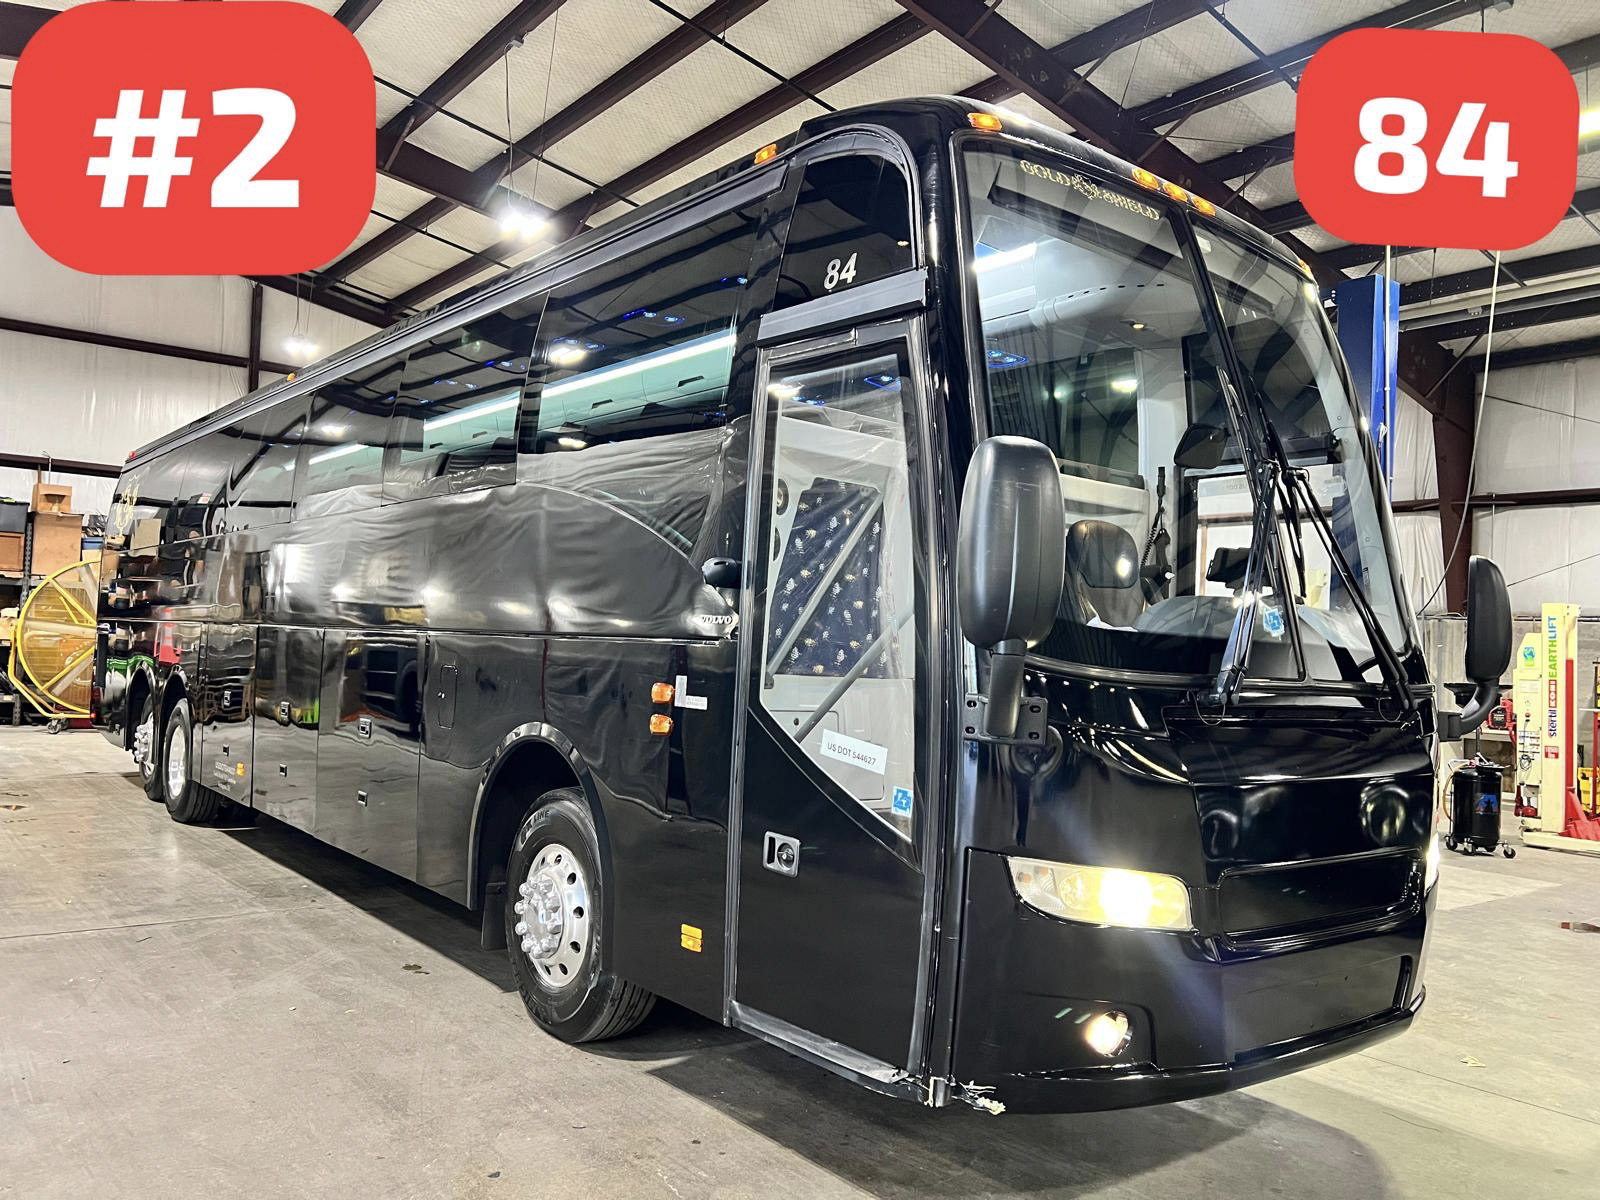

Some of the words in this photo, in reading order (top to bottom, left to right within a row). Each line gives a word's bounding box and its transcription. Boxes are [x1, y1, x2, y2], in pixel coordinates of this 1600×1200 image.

[1020, 160, 1071, 186] GOLD
[1102, 189, 1160, 220] SHIELD
[824, 252, 857, 290] 84
[701, 615, 732, 624] VOLVO
[827, 742, 837, 752] US
[838, 745, 851, 757] DOT
[852, 751, 876, 765] 544627
